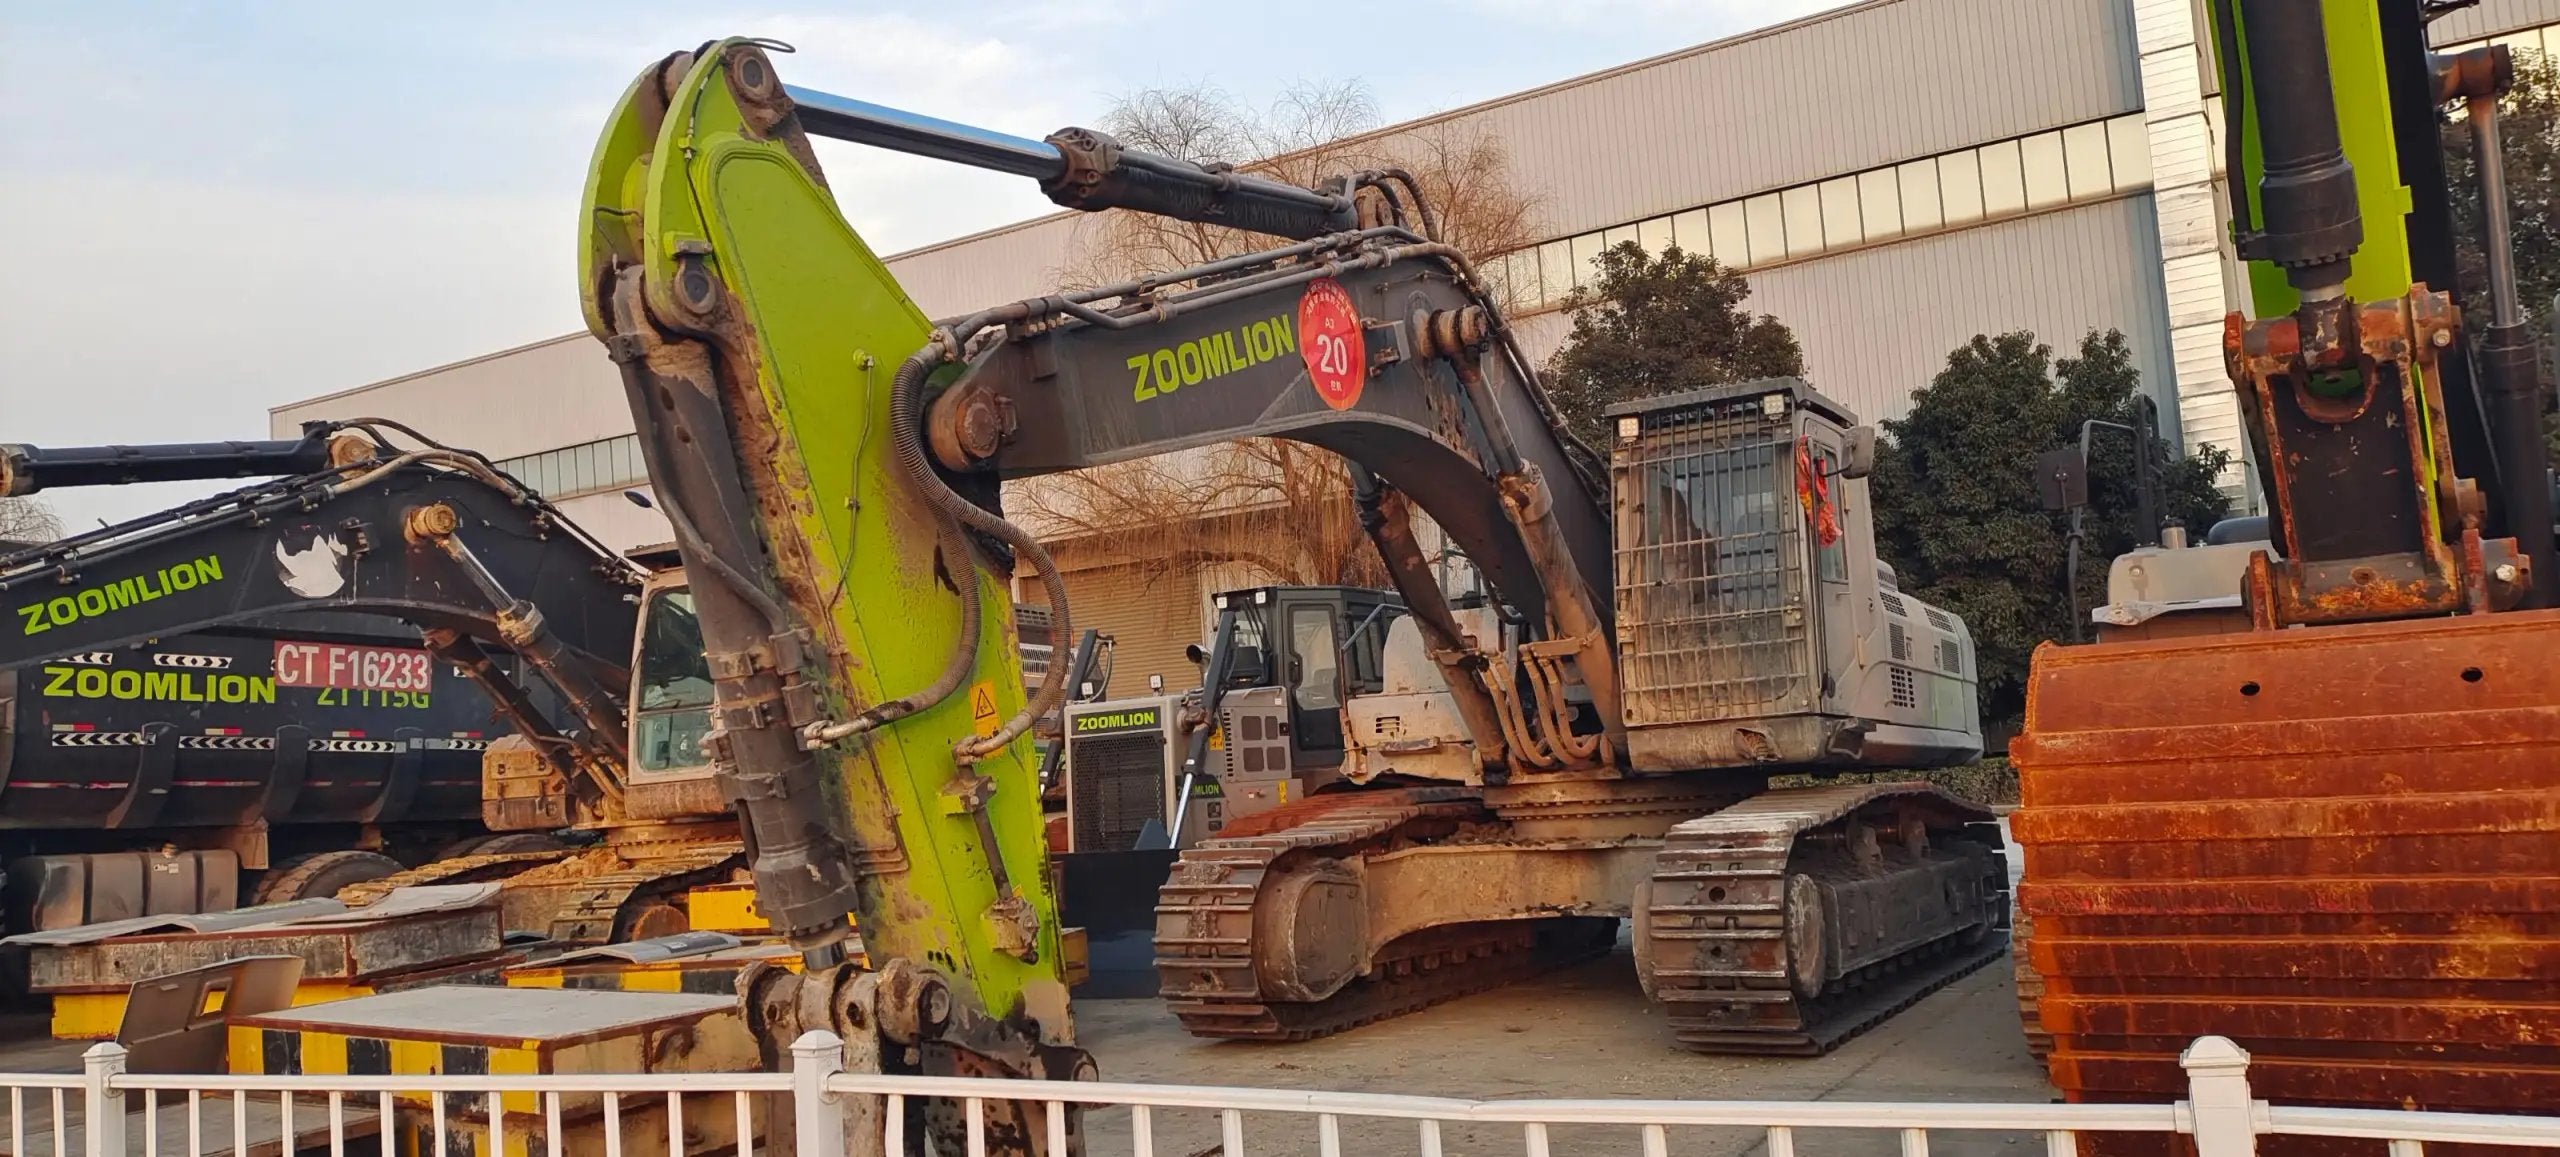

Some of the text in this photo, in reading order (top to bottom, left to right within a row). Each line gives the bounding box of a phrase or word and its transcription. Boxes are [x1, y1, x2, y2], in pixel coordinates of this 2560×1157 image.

[1127, 315, 1295, 401] ZOOMLION
[1317, 333, 1348, 375] 20
[18, 555, 223, 635] ZOOMLION
[43, 666, 276, 704] ZOOMLION
[278, 644, 429, 689] CT F16233
[1078, 711, 1155, 731] ZOOMLION
